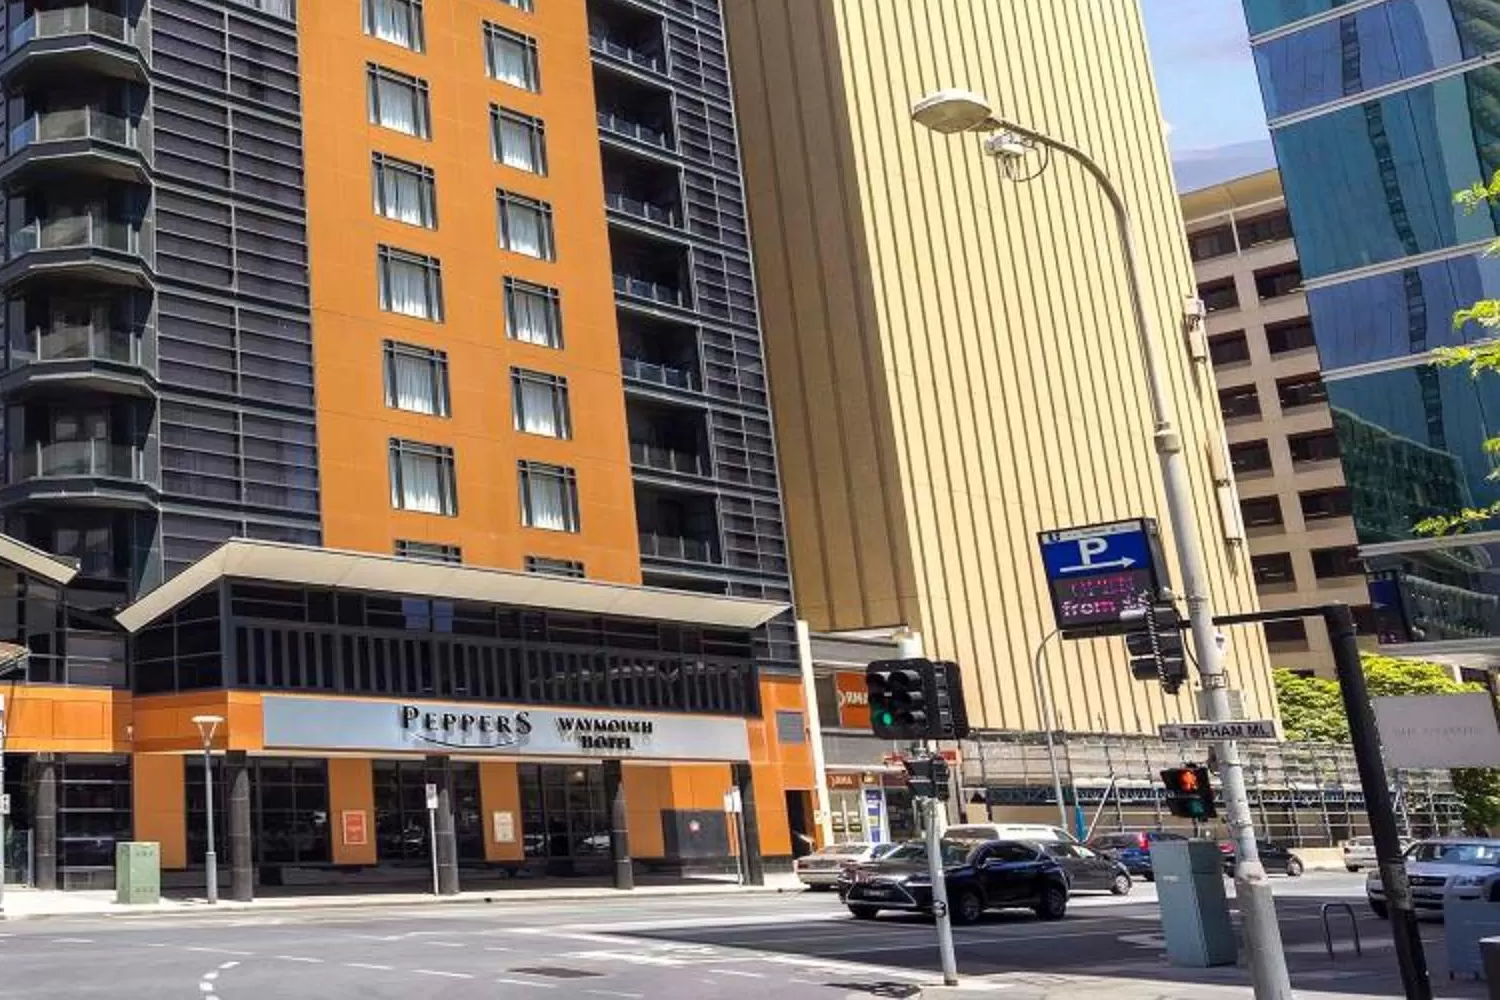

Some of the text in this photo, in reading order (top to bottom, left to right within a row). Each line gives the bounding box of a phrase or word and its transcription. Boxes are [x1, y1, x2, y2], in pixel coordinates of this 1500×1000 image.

[1078, 538, 1108, 565] P
[401, 705, 532, 735] PEPPERS
[1180, 723, 1241, 739] TOPHAM
